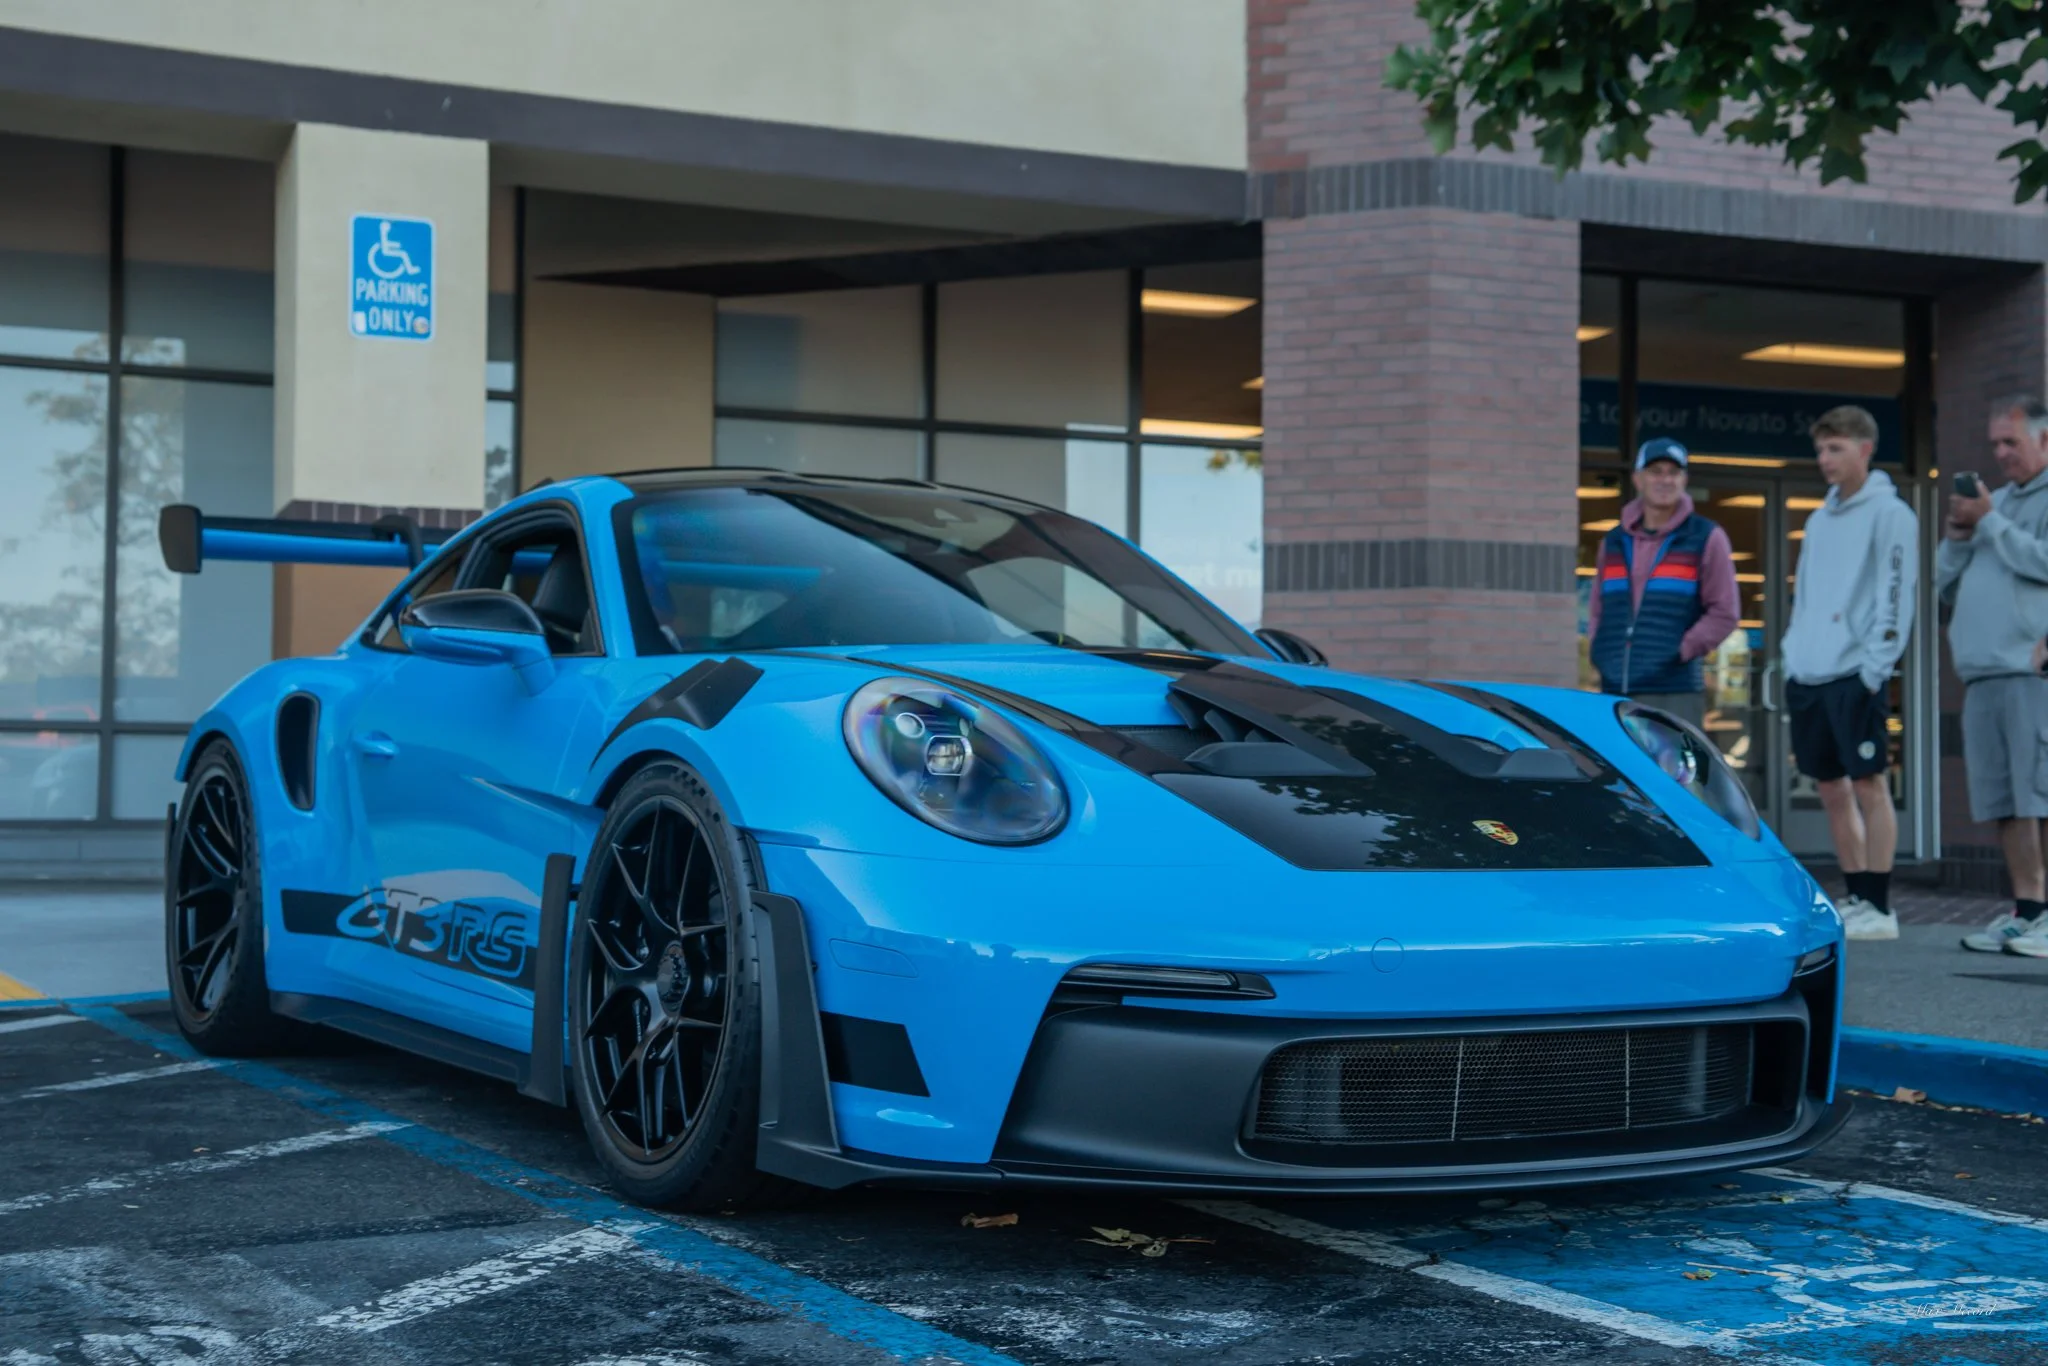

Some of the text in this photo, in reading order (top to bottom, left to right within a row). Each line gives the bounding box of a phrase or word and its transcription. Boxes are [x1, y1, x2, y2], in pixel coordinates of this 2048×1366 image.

[355, 277, 429, 307] PARKING
[368, 305, 415, 332] ONLY
[1634, 407, 1690, 431] your
[1698, 404, 1787, 434] Novato
